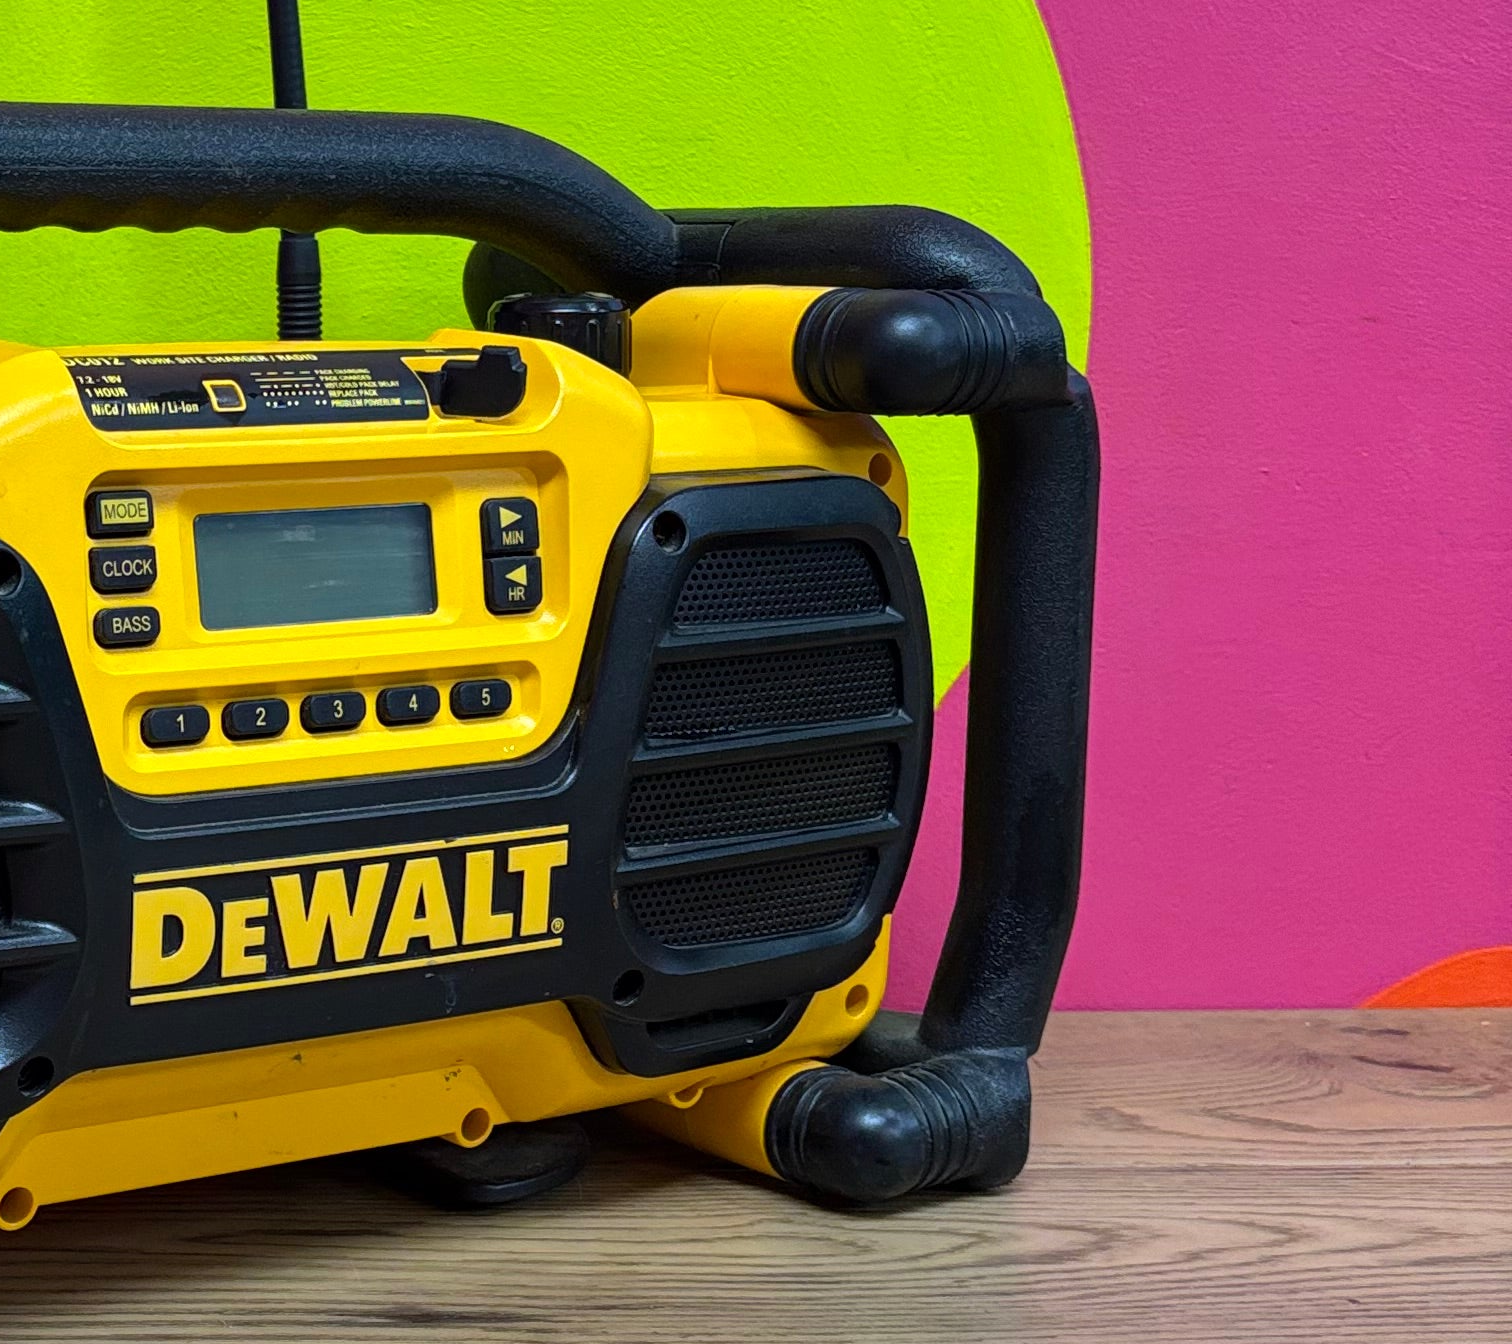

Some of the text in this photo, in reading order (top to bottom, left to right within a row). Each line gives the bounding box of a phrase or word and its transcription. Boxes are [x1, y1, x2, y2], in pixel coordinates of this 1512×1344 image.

[175, 356, 206, 365] SITE
[208, 355, 268, 364] CHARGER
[275, 353, 318, 361] RADIO
[85, 387, 128, 398] 1 HOUR
[91, 402, 119, 416] NiCd
[128, 401, 160, 415] NiMH
[167, 401, 199, 414] Li-Ion
[104, 502, 147, 520] MODE
[502, 530, 524, 545] MIN
[102, 559, 153, 577] CLOCK
[508, 586, 526, 601] HR
[112, 615, 152, 634] BASS
[176, 688, 491, 733] 1 2 3 4 5
